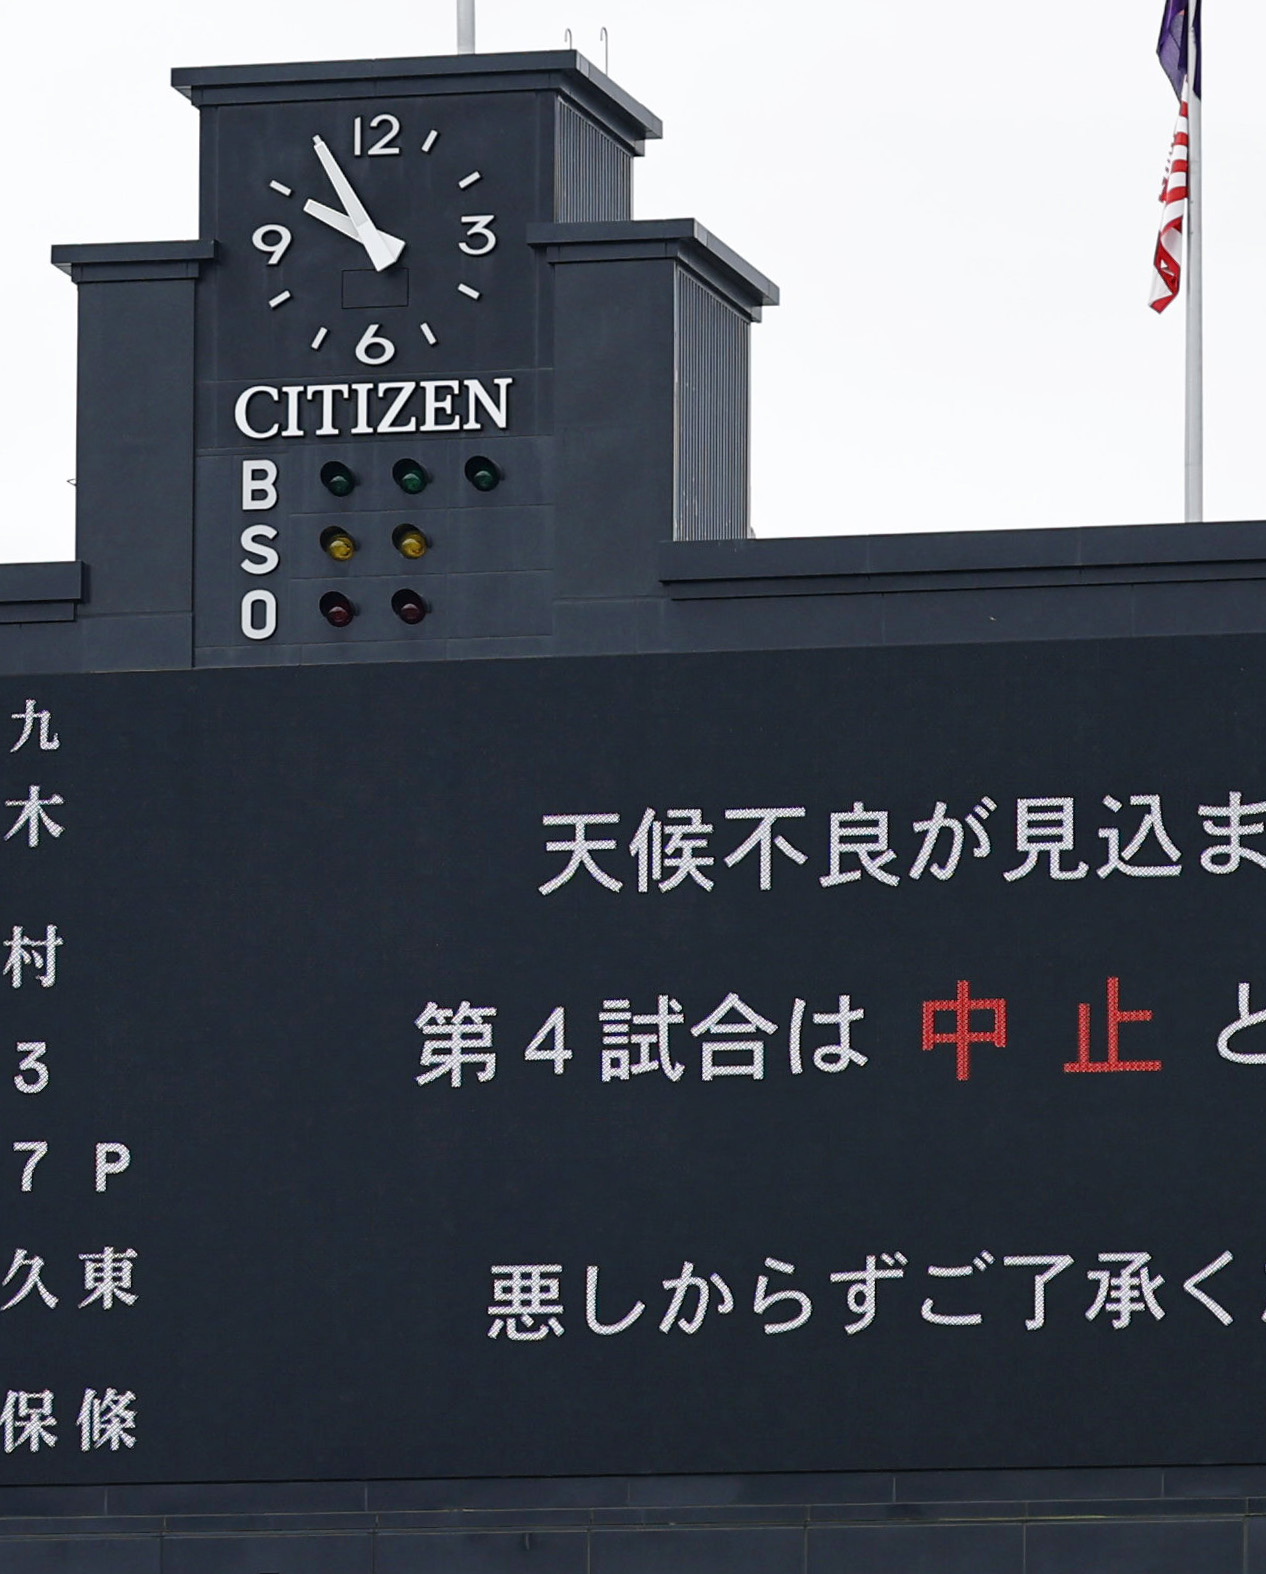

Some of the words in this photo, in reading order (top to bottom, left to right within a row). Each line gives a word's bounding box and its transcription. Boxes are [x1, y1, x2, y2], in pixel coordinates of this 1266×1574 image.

[353, 114, 400, 156] 12
[252, 224, 292, 265] 9
[459, 215, 496, 255] 3
[355, 324, 395, 365] 6
[234, 377, 513, 439] CITIZEN
[242, 459, 278, 510] B
[240, 524, 279, 575] S
[241, 589, 277, 640] O
[10, 700, 60, 753] 九
[14, 1041, 49, 1094] 3
[13, 1141, 48, 1192] 7
[95, 1142, 131, 1192] P
